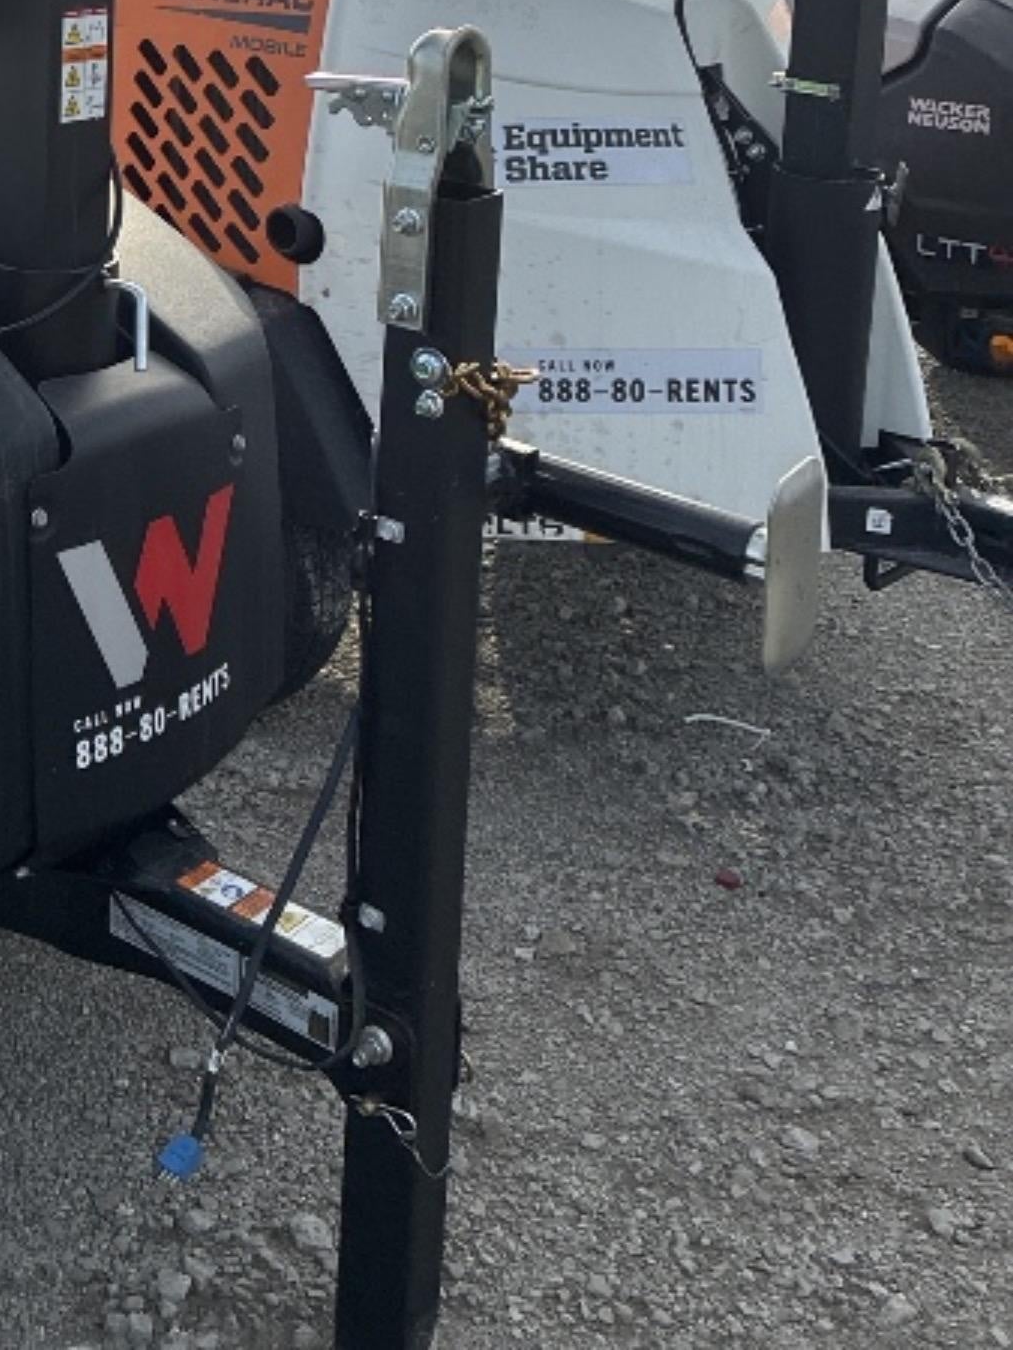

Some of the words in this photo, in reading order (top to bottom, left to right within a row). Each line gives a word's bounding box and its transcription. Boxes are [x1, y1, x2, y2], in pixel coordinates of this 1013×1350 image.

[229, 35, 307, 58] MOBILE
[909, 96, 991, 121] WACKER
[907, 110, 991, 136] NEUSON
[502, 123, 685, 155] Equipment
[504, 155, 609, 183] Share
[538, 359, 576, 372] CALL
[583, 359, 616, 372] NOW
[538, 377, 757, 403] 888-80-RENTS
[76, 662, 231, 770] 888-80-RENTS
